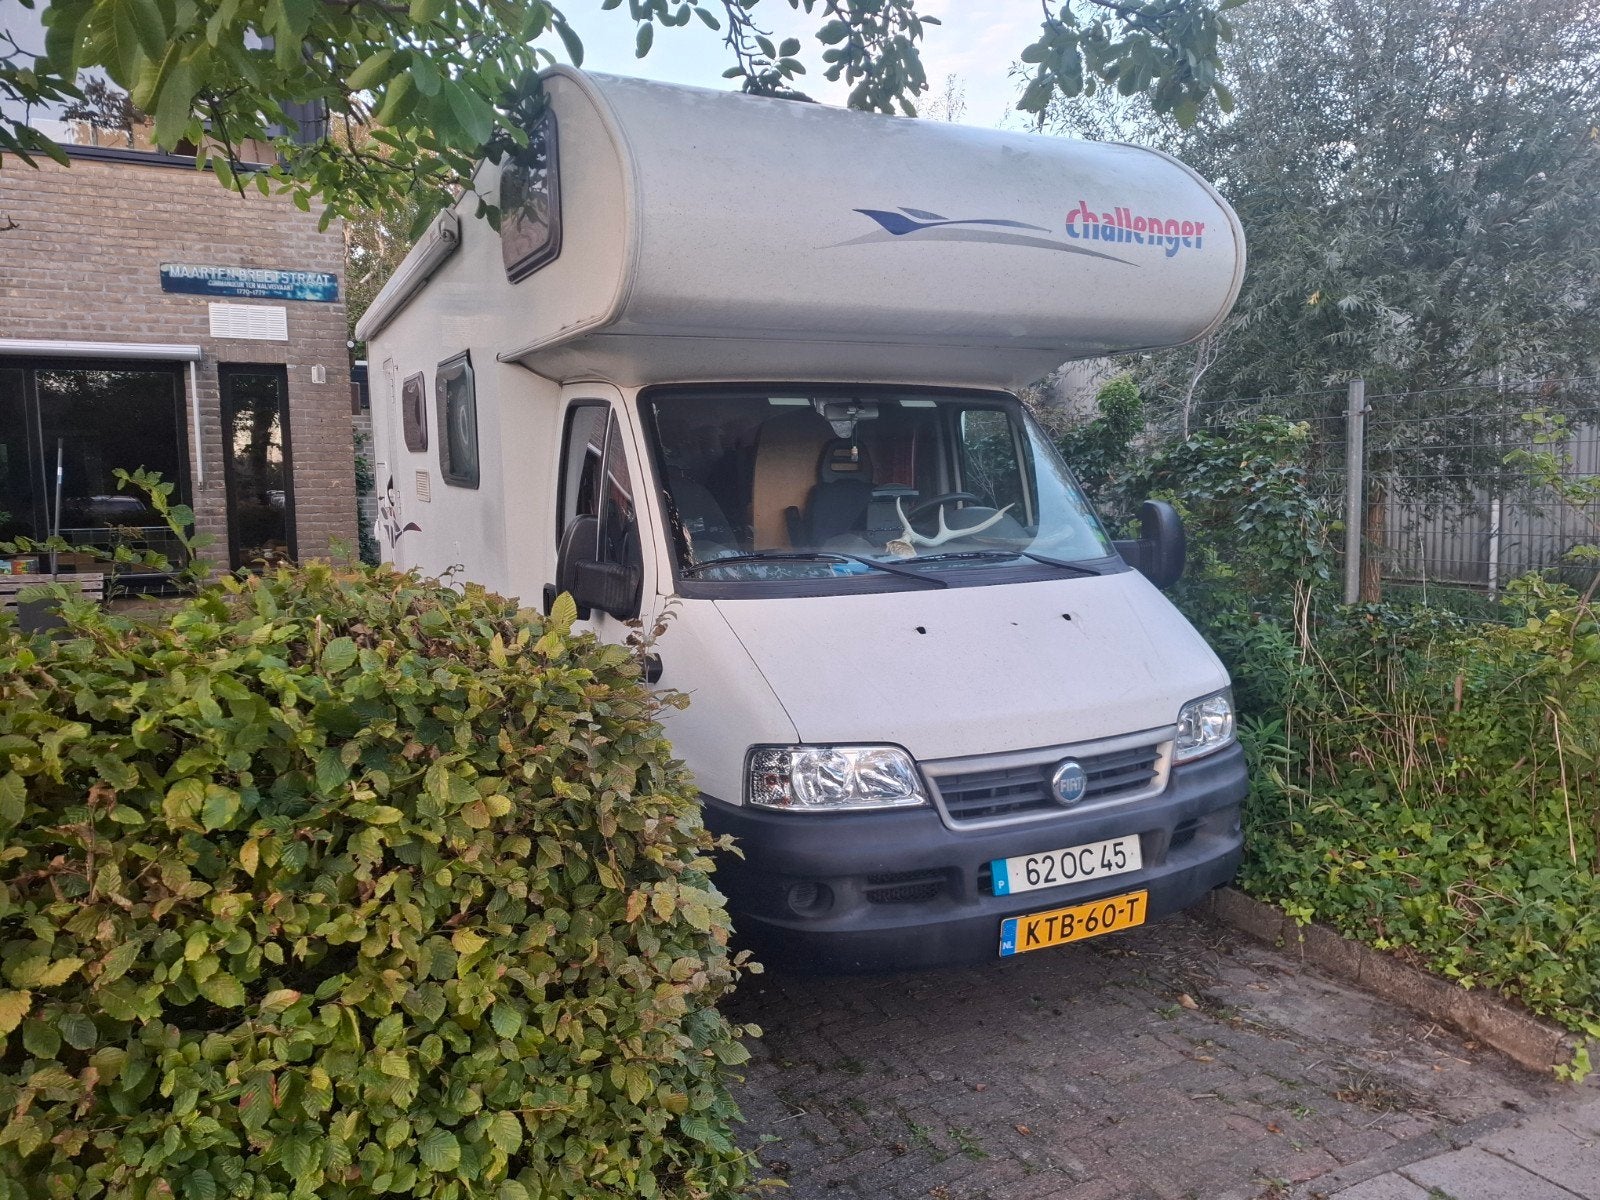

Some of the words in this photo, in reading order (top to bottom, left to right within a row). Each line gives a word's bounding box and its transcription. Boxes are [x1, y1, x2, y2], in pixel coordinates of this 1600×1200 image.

[1065, 200, 1205, 258] challenger
[169, 265, 236, 281] MAARTEN
[1059, 776, 1083, 793] FIAT
[998, 880, 1005, 889] P
[1002, 941, 1014, 950] NL
[1025, 897, 1140, 947] KTB-60-T
